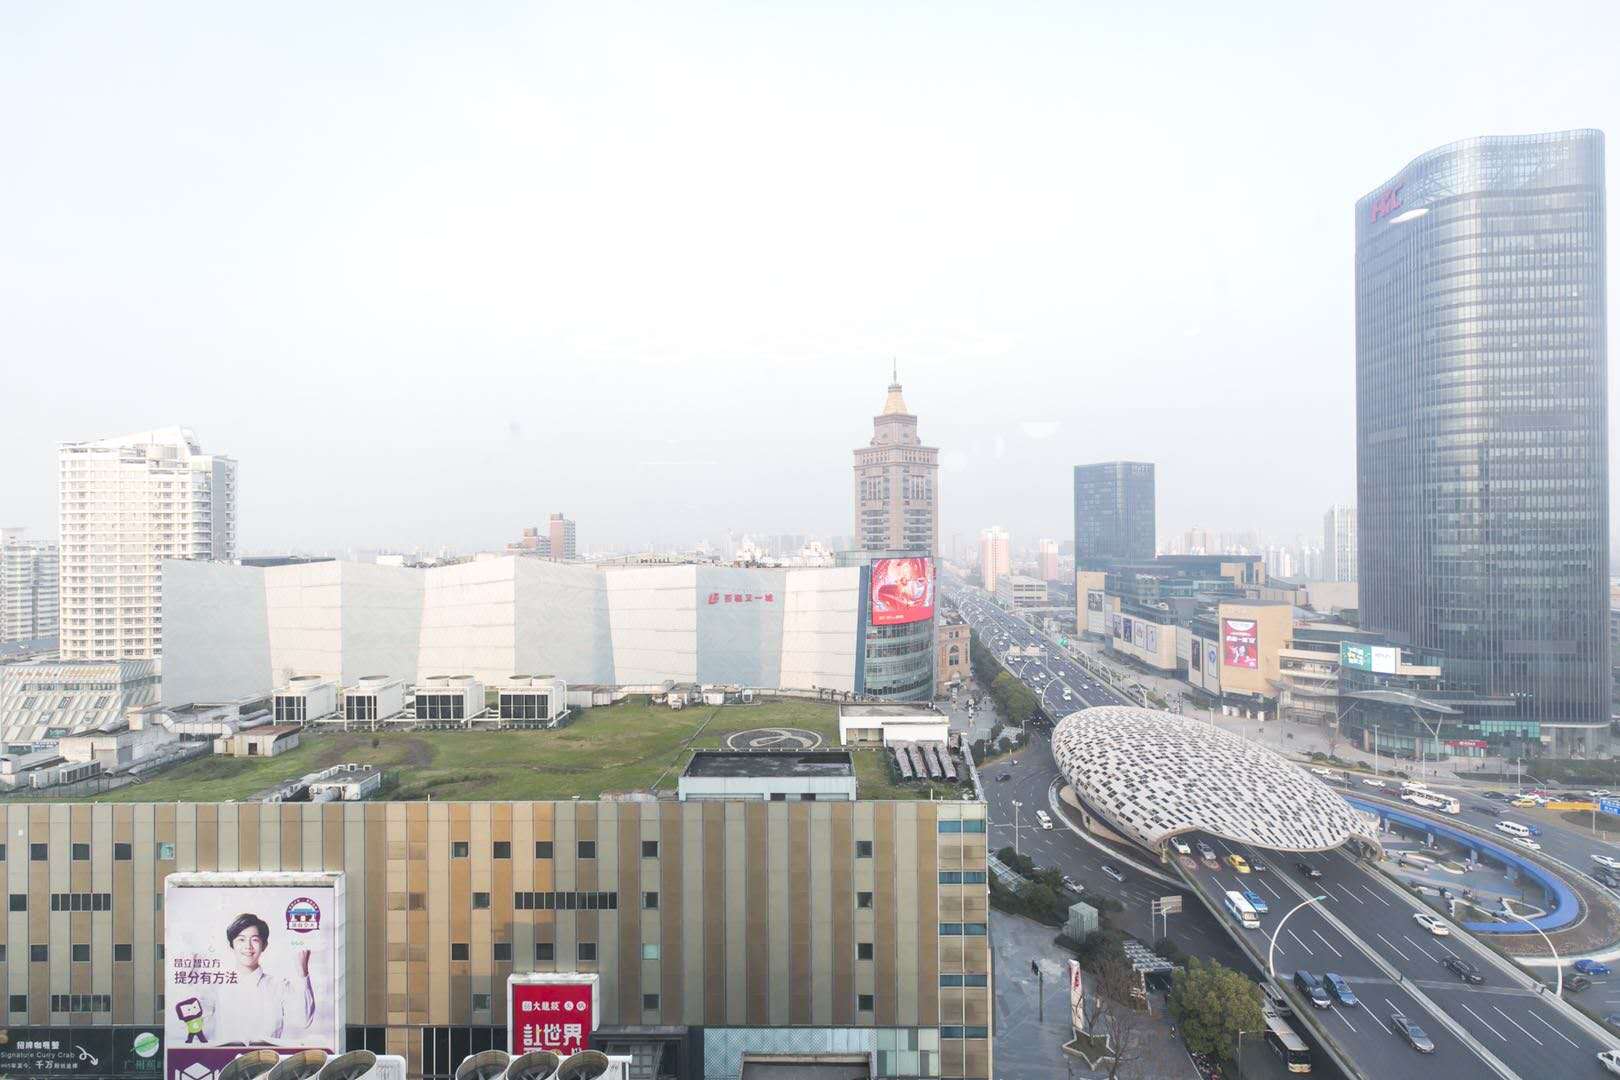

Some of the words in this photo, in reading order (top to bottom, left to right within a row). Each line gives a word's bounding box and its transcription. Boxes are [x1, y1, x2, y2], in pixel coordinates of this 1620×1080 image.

[174, 971, 238, 984] 提分有方法
